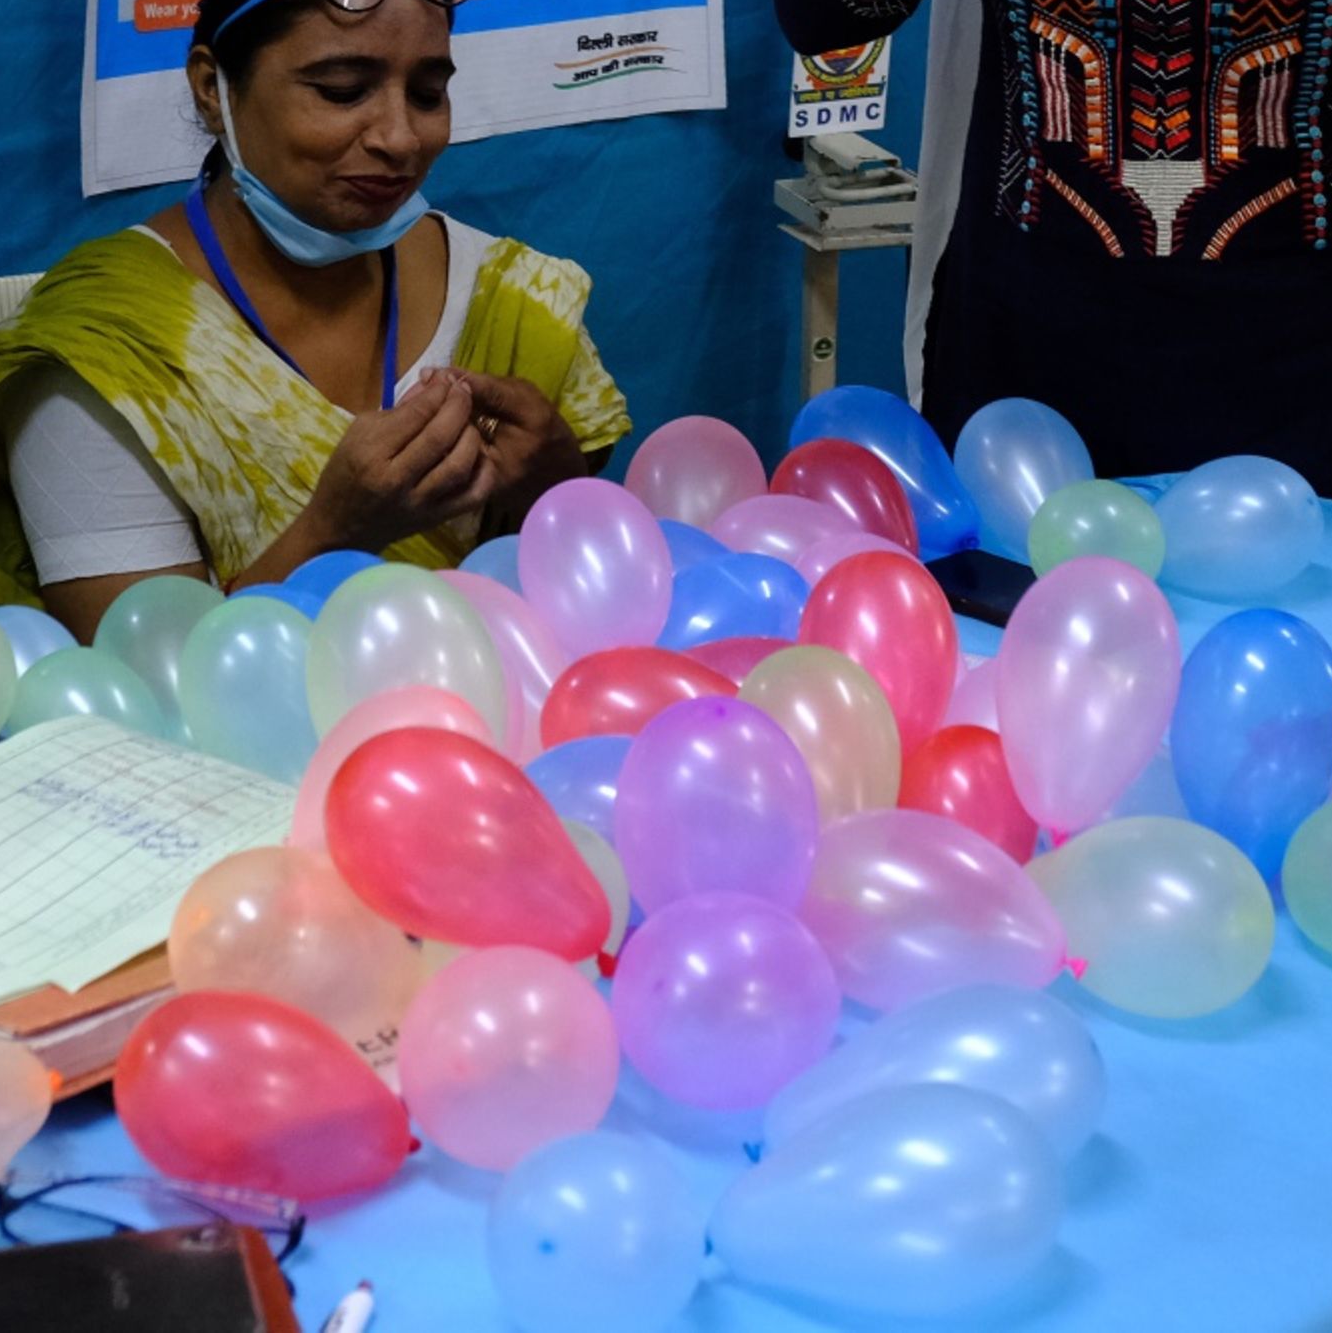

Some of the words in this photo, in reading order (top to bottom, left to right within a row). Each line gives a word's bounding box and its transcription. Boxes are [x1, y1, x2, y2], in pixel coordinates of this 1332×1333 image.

[143, 3, 177, 18] Wear
[578, 32, 614, 52] दिल्ली
[618, 30, 658, 48] सरकार
